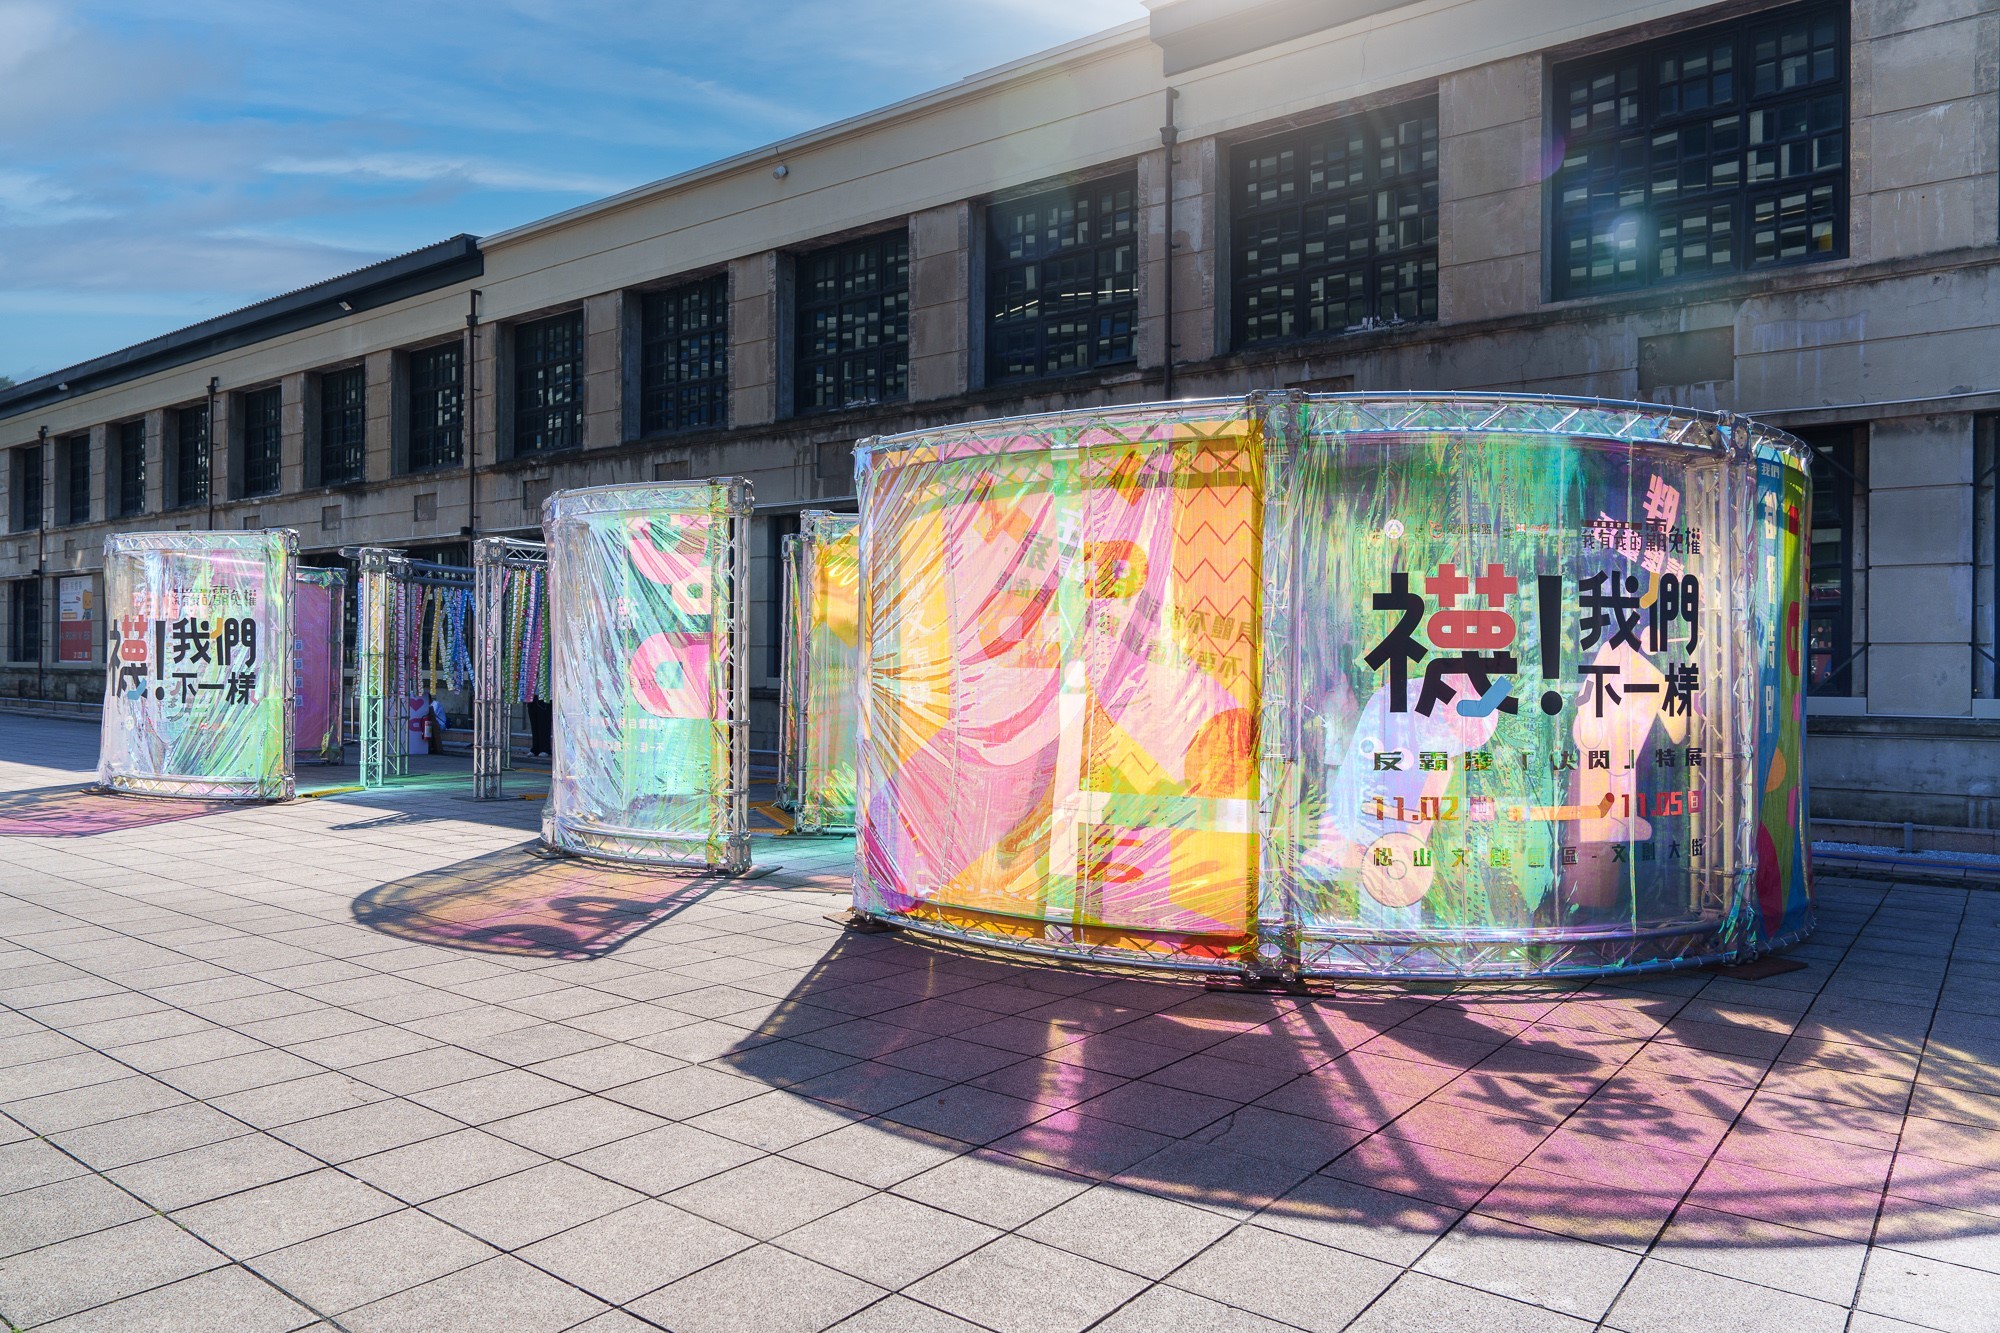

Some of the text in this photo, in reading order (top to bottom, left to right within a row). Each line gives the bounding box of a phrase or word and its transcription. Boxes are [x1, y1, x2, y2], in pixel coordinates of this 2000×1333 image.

[1578, 570, 1700, 656] 我們
[173, 617, 256, 668] 我們
[172, 672, 256, 705] 不一樣
[1577, 663, 1700, 718] 不一樣
[1373, 797, 1459, 821] 11.02
[1622, 791, 1683, 818] 11.05
